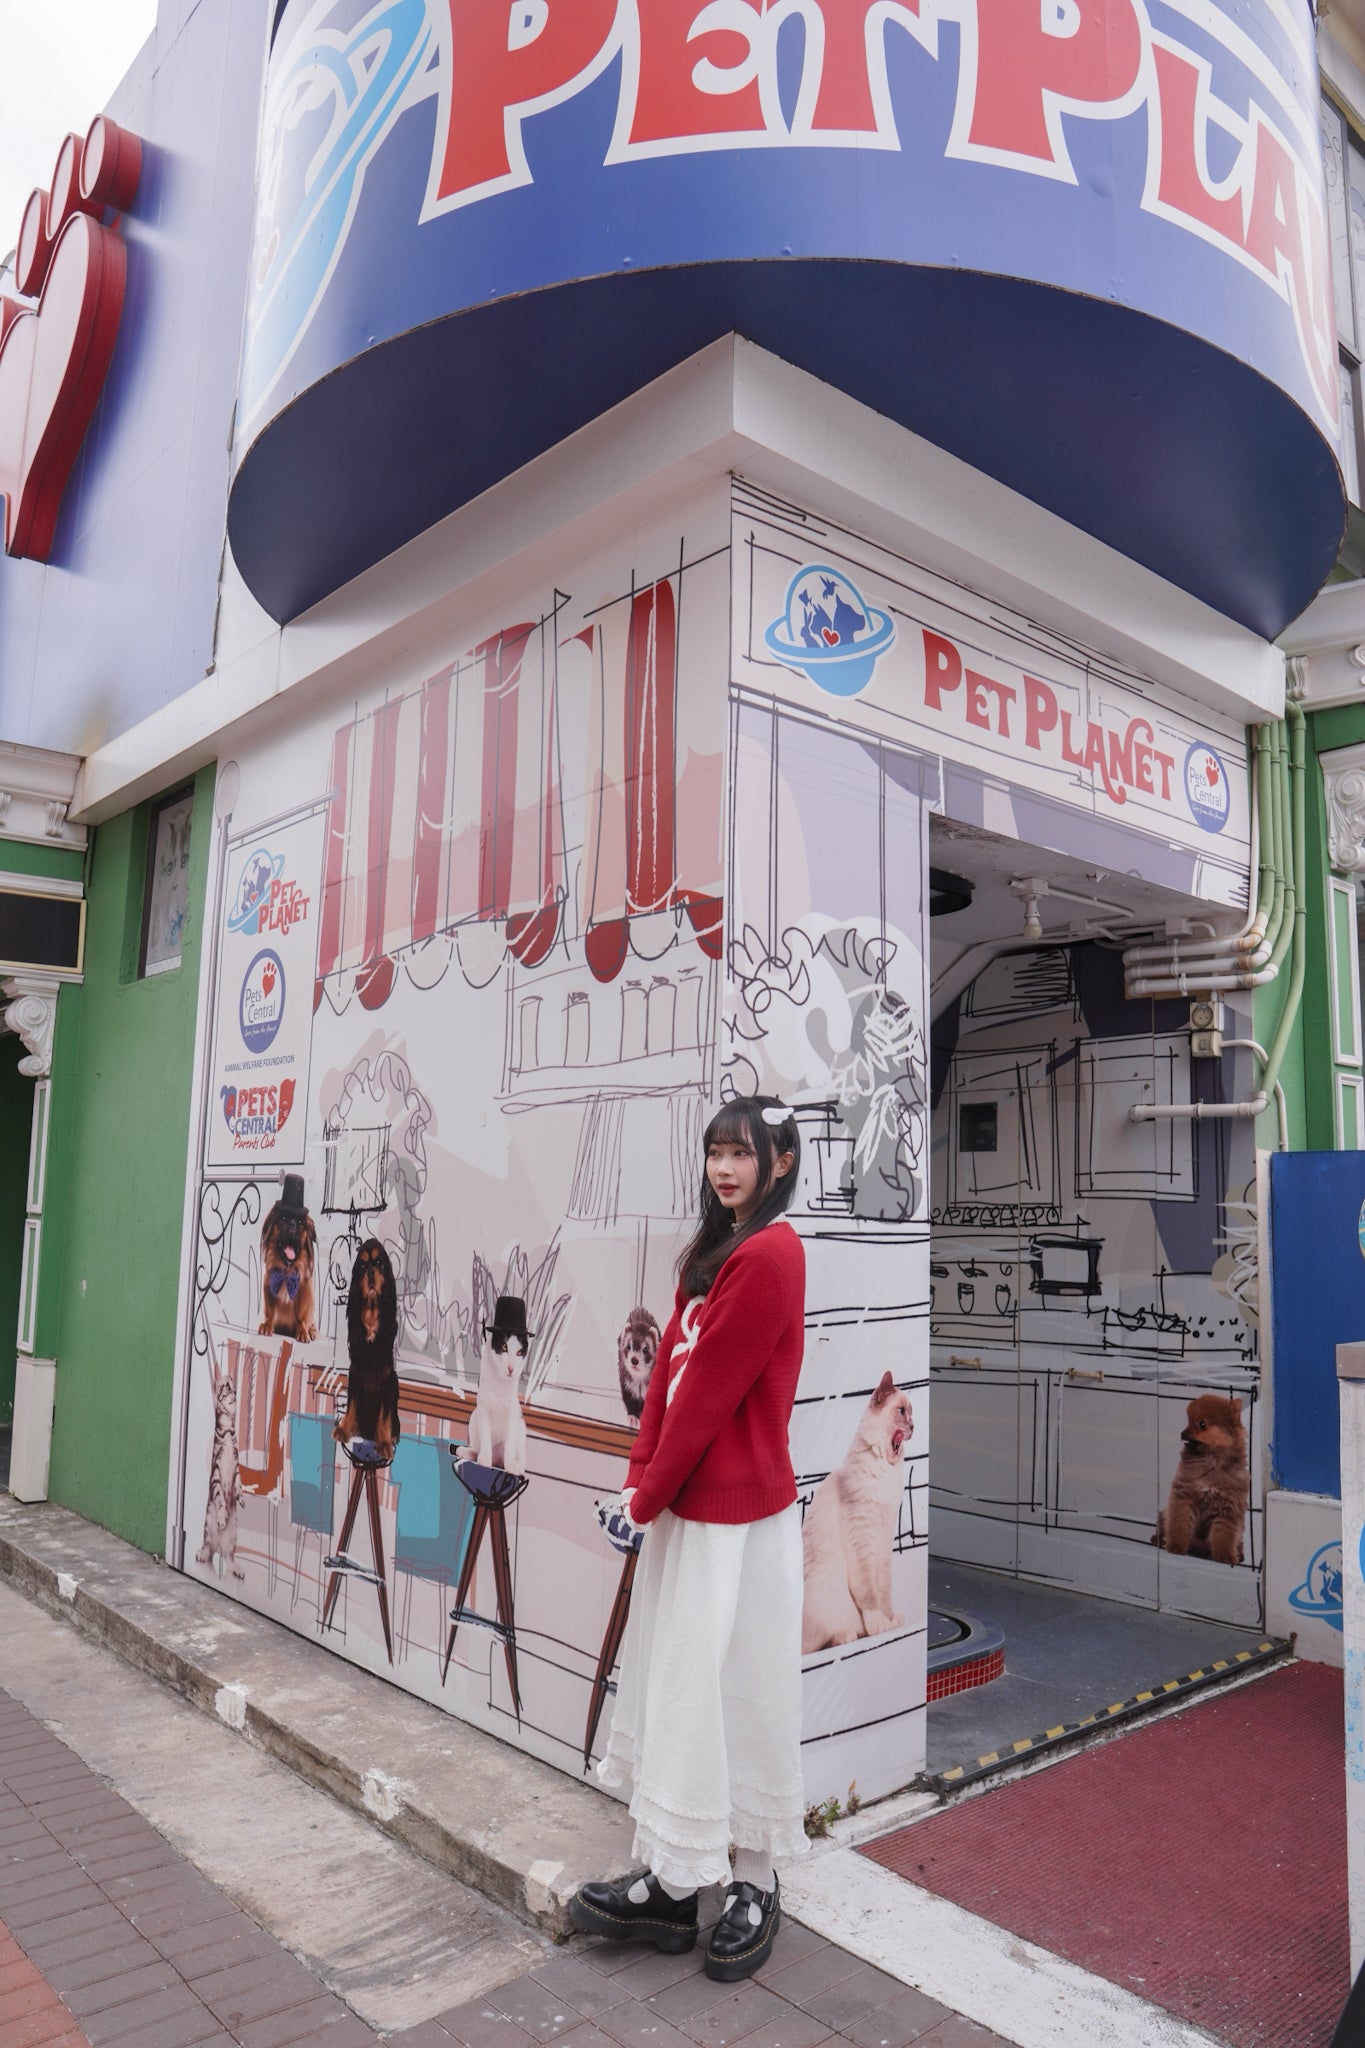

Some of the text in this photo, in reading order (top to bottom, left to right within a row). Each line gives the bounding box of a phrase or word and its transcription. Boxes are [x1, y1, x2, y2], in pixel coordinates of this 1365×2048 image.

[422, 0, 945, 221] PET
[922, 629, 1175, 804] PET PLANET
[1190, 767, 1207, 787] Pets
[1194, 785, 1222, 808] Central
[270, 879, 296, 908] PET
[258, 889, 310, 935] PLANET
[245, 988, 262, 1008] Pets
[248, 1000, 276, 1023] Central
[224, 1054, 295, 1073] ANIMAL WELFARE FOUNDATION
[237, 1085, 278, 1118] PETS
[235, 1115, 277, 1136] CENTRAL
[233, 1133, 277, 1150] Parents Club
